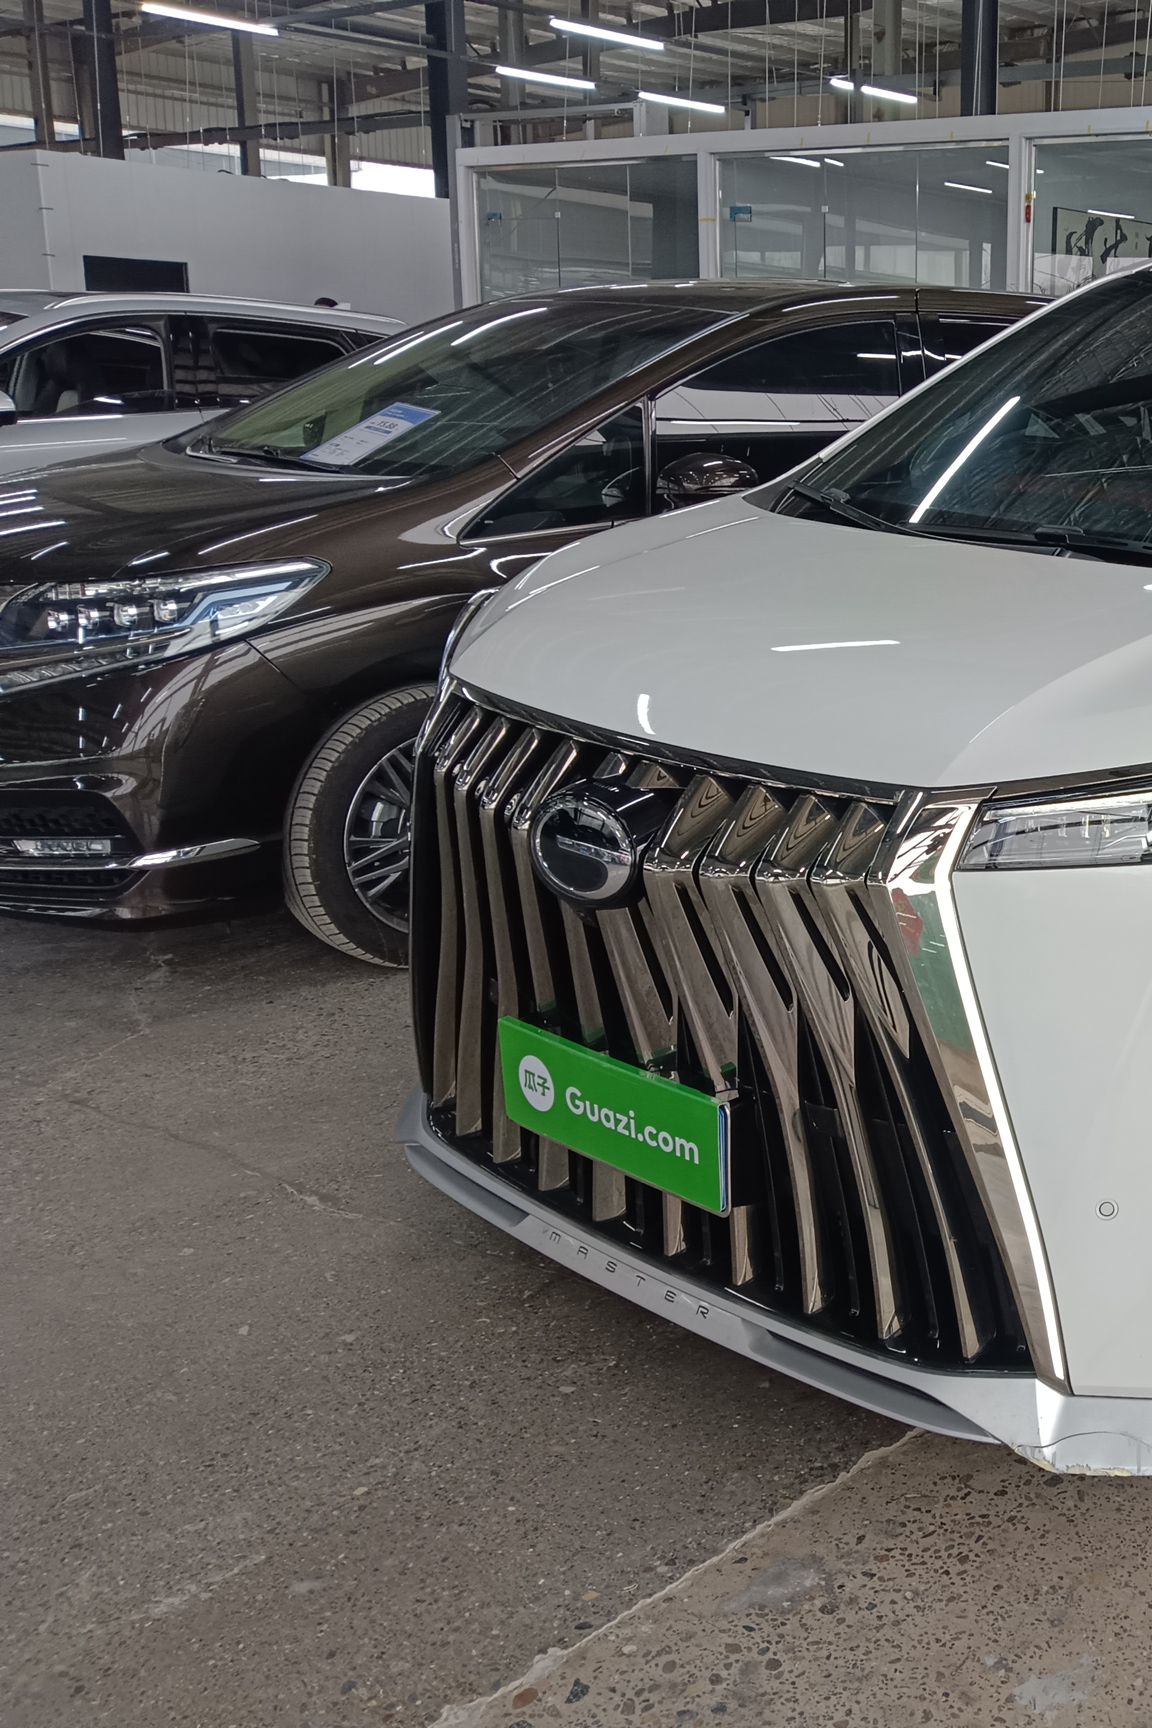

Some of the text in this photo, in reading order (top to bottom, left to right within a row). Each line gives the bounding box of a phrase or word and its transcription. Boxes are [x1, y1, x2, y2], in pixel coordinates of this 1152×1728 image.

[524, 1069, 550, 1097] 瓜子
[565, 1086, 700, 1165] Guazi.com
[550, 1231, 710, 1320] MASTER
